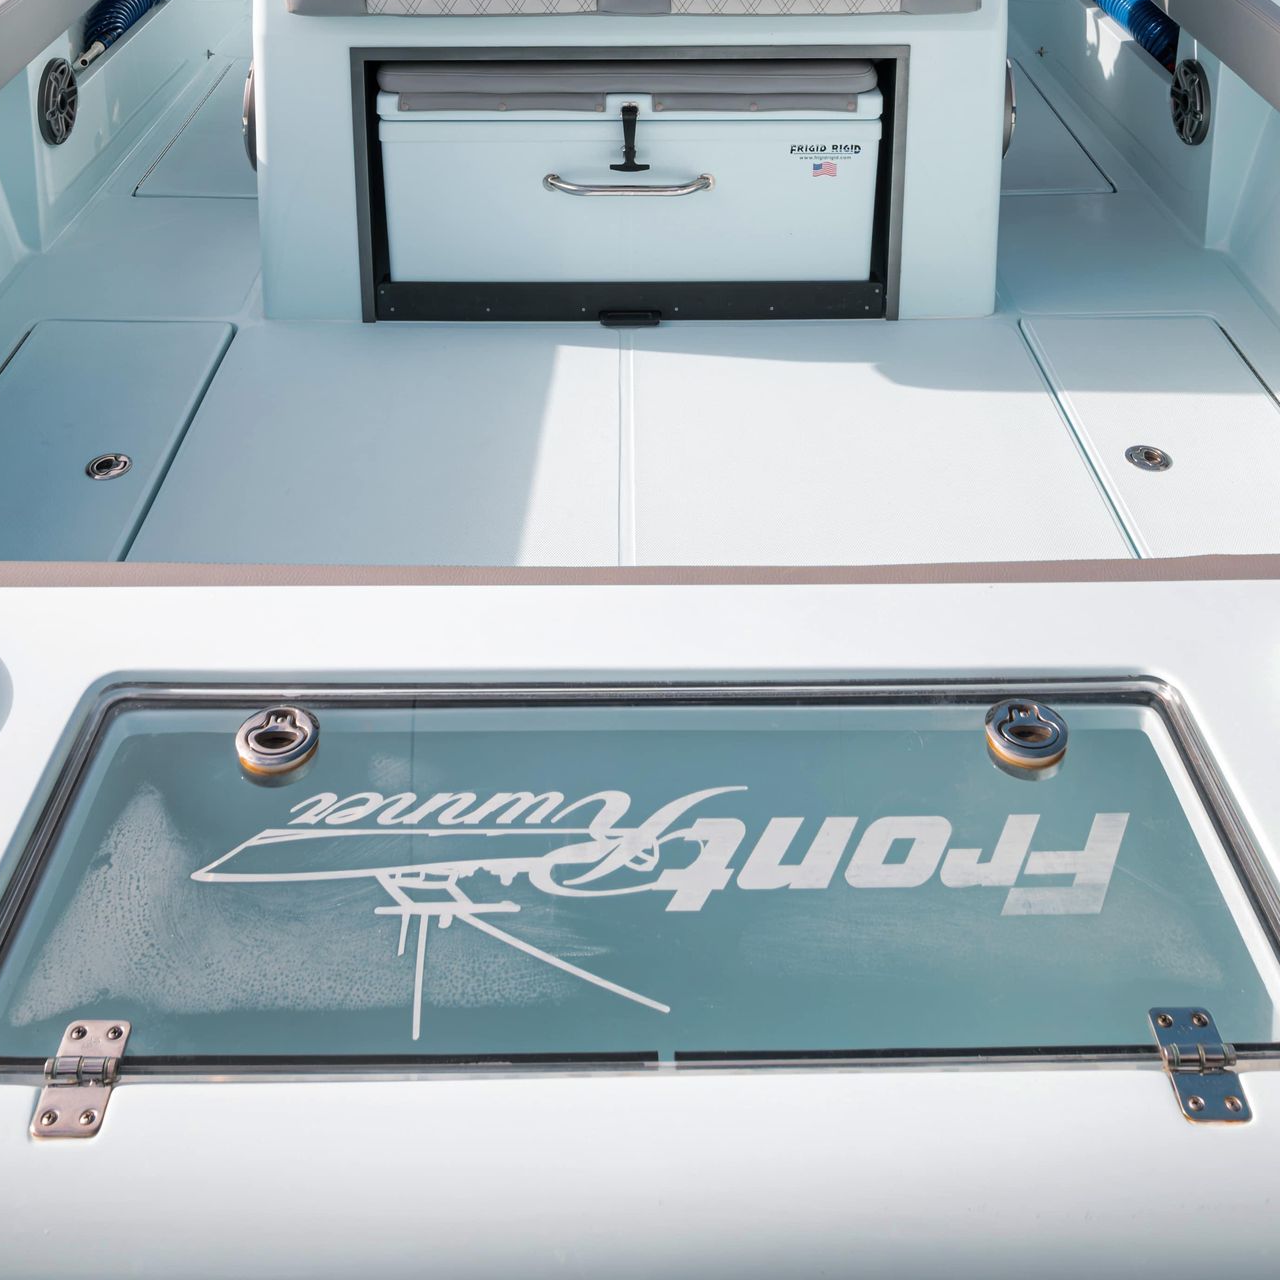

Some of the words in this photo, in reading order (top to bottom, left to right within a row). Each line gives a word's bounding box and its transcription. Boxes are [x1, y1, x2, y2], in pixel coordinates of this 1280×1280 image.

[790, 144, 827, 154] FRIGID
[832, 144, 862, 154] RIGID
[290, 786, 750, 896] Runner
[646, 811, 1132, 916] Front
